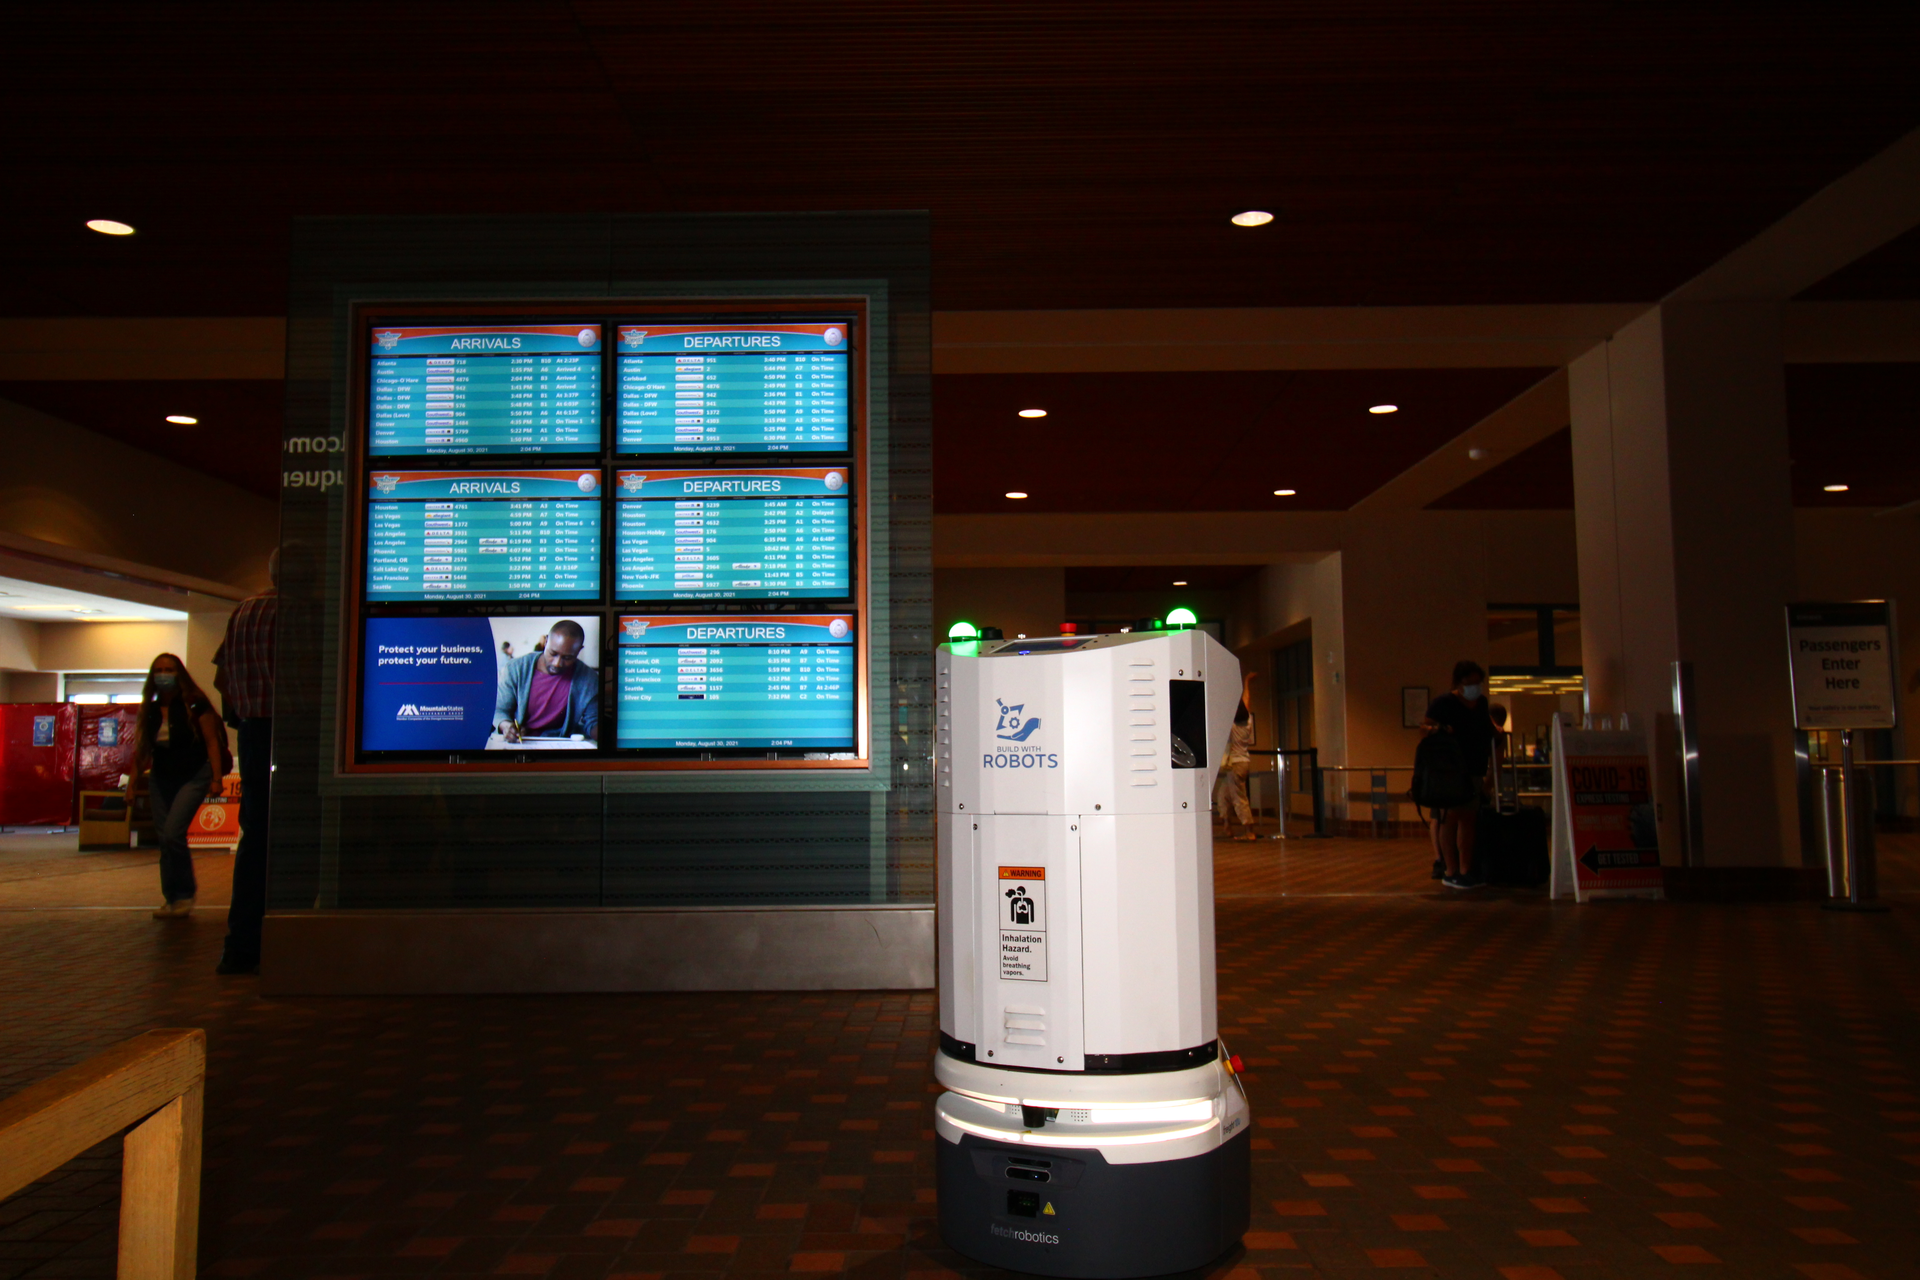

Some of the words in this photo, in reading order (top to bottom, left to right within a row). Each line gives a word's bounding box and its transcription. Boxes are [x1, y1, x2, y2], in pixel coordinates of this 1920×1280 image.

[451, 338, 521, 349] ARRIVALS
[684, 336, 781, 348] DEPARTURES
[449, 482, 520, 494] ARRIVALS
[683, 480, 781, 492] DEPARTURES
[687, 627, 785, 639] DEPARTURES
[416, 646, 437, 655] your
[441, 645, 483, 654] business,
[1800, 640, 1881, 652] Passengers
[378, 657, 413, 666] protect
[416, 658, 437, 666] your
[440, 656, 471, 664] future.
[1822, 659, 1860, 670] Enter
[1826, 678, 1860, 689] Here
[983, 754, 1058, 768] ROBOTS
[1572, 767, 1647, 790] COVID-19
[1576, 794, 1604, 803] EXPRESS
[1605, 793, 1630, 803] TESTING
[1598, 853, 1611, 865] GET
[1613, 853, 1639, 864] TESTED
[1010, 869, 1042, 878] WARNING
[1002, 934, 1042, 943] Inhalation
[1002, 944, 1032, 953] Hazard.
[1002, 962, 1030, 970] breathing
[991, 1224, 1059, 1244] fetchrobotics
